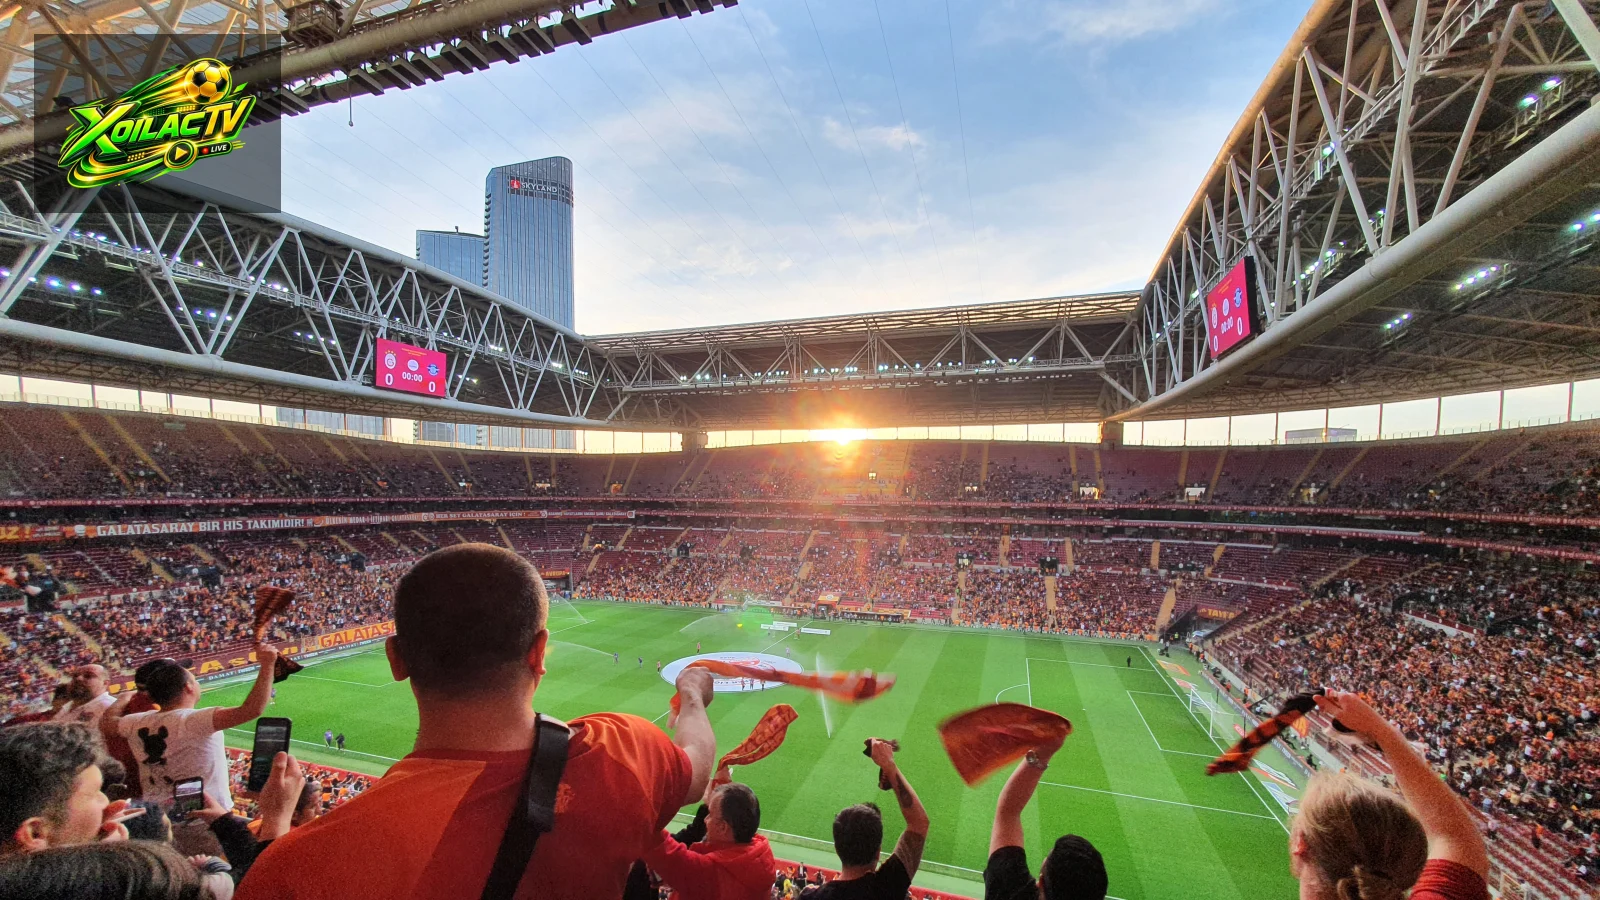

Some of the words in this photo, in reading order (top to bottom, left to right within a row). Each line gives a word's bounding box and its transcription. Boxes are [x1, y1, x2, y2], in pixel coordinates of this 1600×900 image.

[521, 181, 558, 193] SKYLAND
[385, 373, 393, 385] 0
[402, 371, 422, 382] 00:00
[428, 381, 436, 392] 0
[96, 522, 196, 536] GALATASARAY
[246, 518, 305, 530] TAKIMIDIR!
[208, 668, 235, 681] DAMAT
